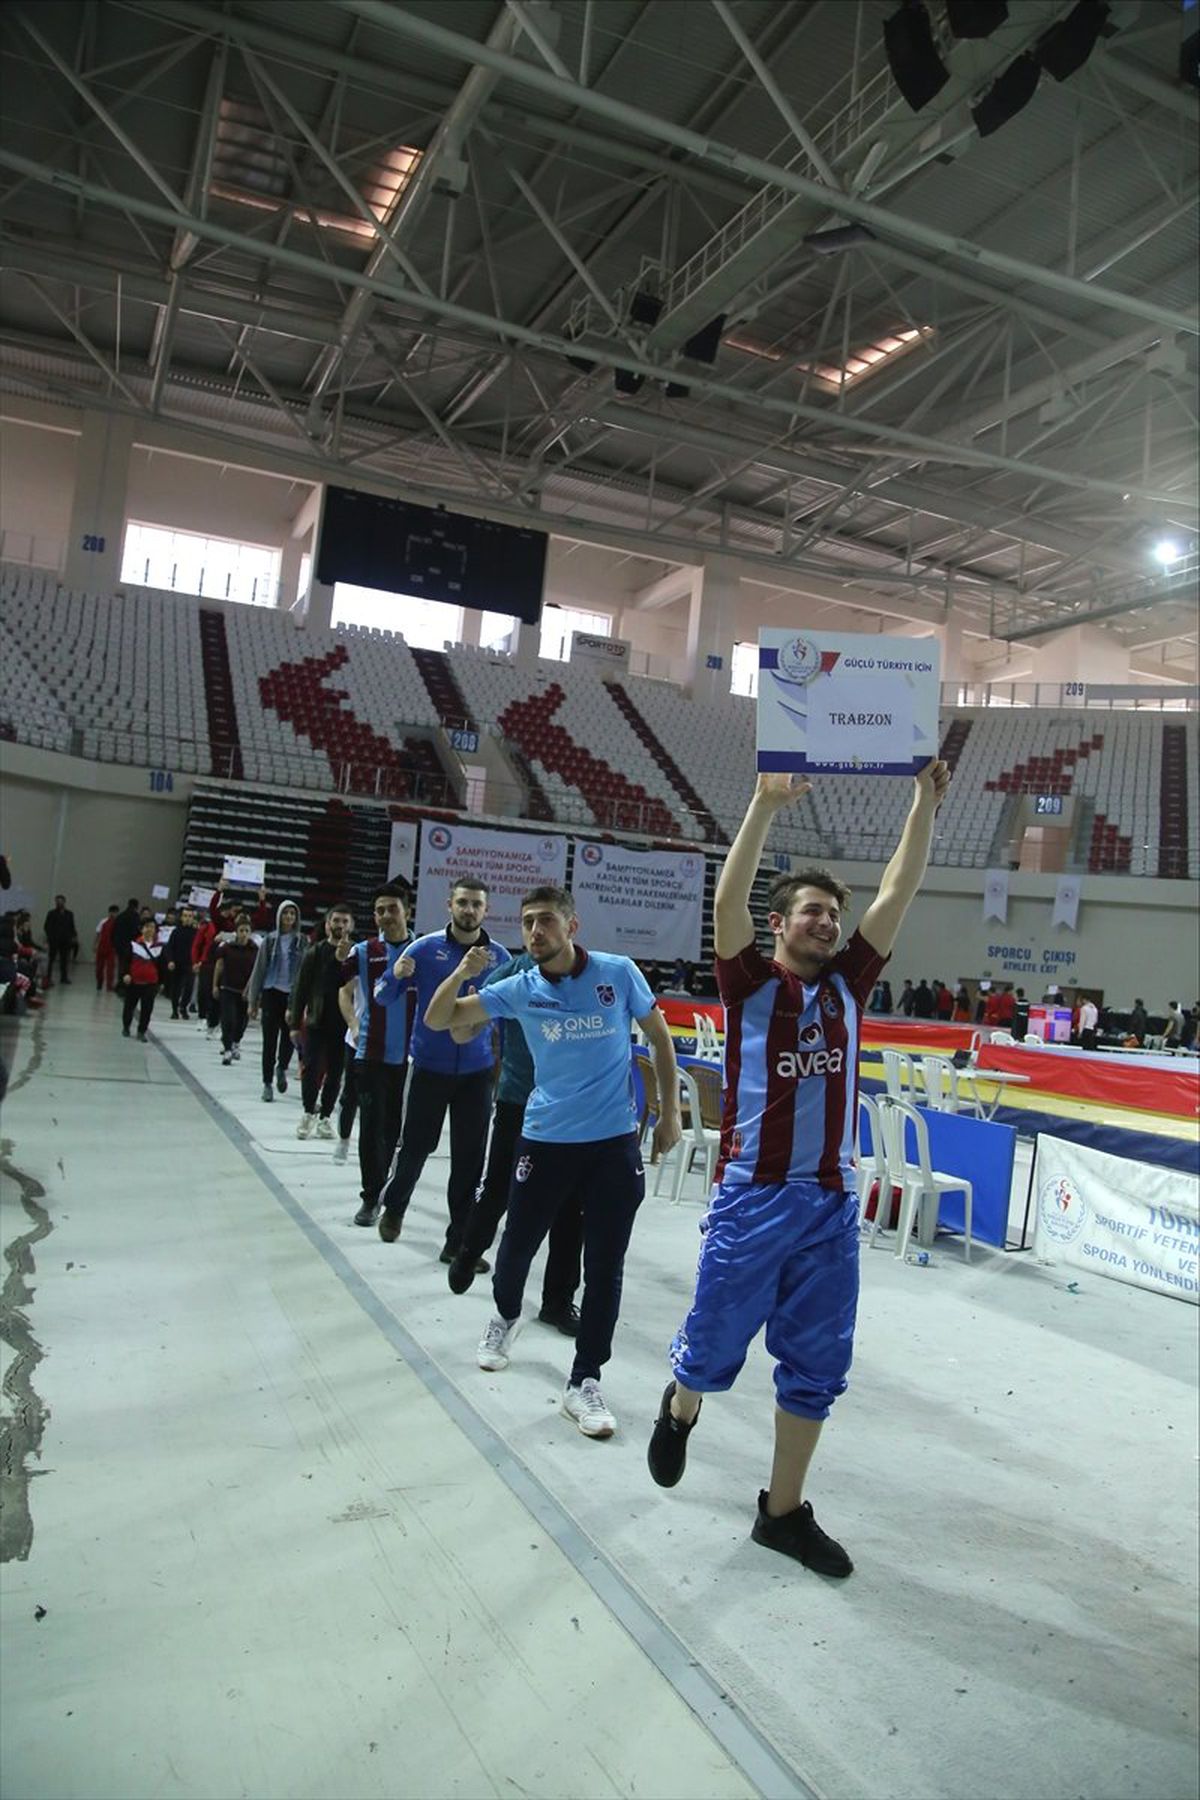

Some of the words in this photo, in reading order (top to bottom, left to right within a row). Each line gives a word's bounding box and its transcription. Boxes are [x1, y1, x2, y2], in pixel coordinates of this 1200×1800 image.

[844, 658, 875, 669] GÜÇLÜ
[877, 660, 912, 671] TÜRKİYE
[914, 662, 932, 672] İÇİN
[1065, 682, 1084, 696] 209
[828, 712, 893, 726] TRABZON
[1037, 797, 1061, 814] 209
[632, 876, 649, 885] TÜM
[624, 888, 635, 896] VE
[987, 945, 1032, 960] SPORCU
[1043, 949, 1076, 966] ÇIKIŞI
[1003, 961, 1037, 973] ATHLETE
[1040, 963, 1058, 973] EXIT
[564, 1015, 604, 1031] QNB
[776, 1047, 843, 1078] avea
[1094, 1212, 1149, 1240] SPORTİF
[1083, 1242, 1128, 1269] SPORA
[1178, 1257, 1198, 1275] VE
